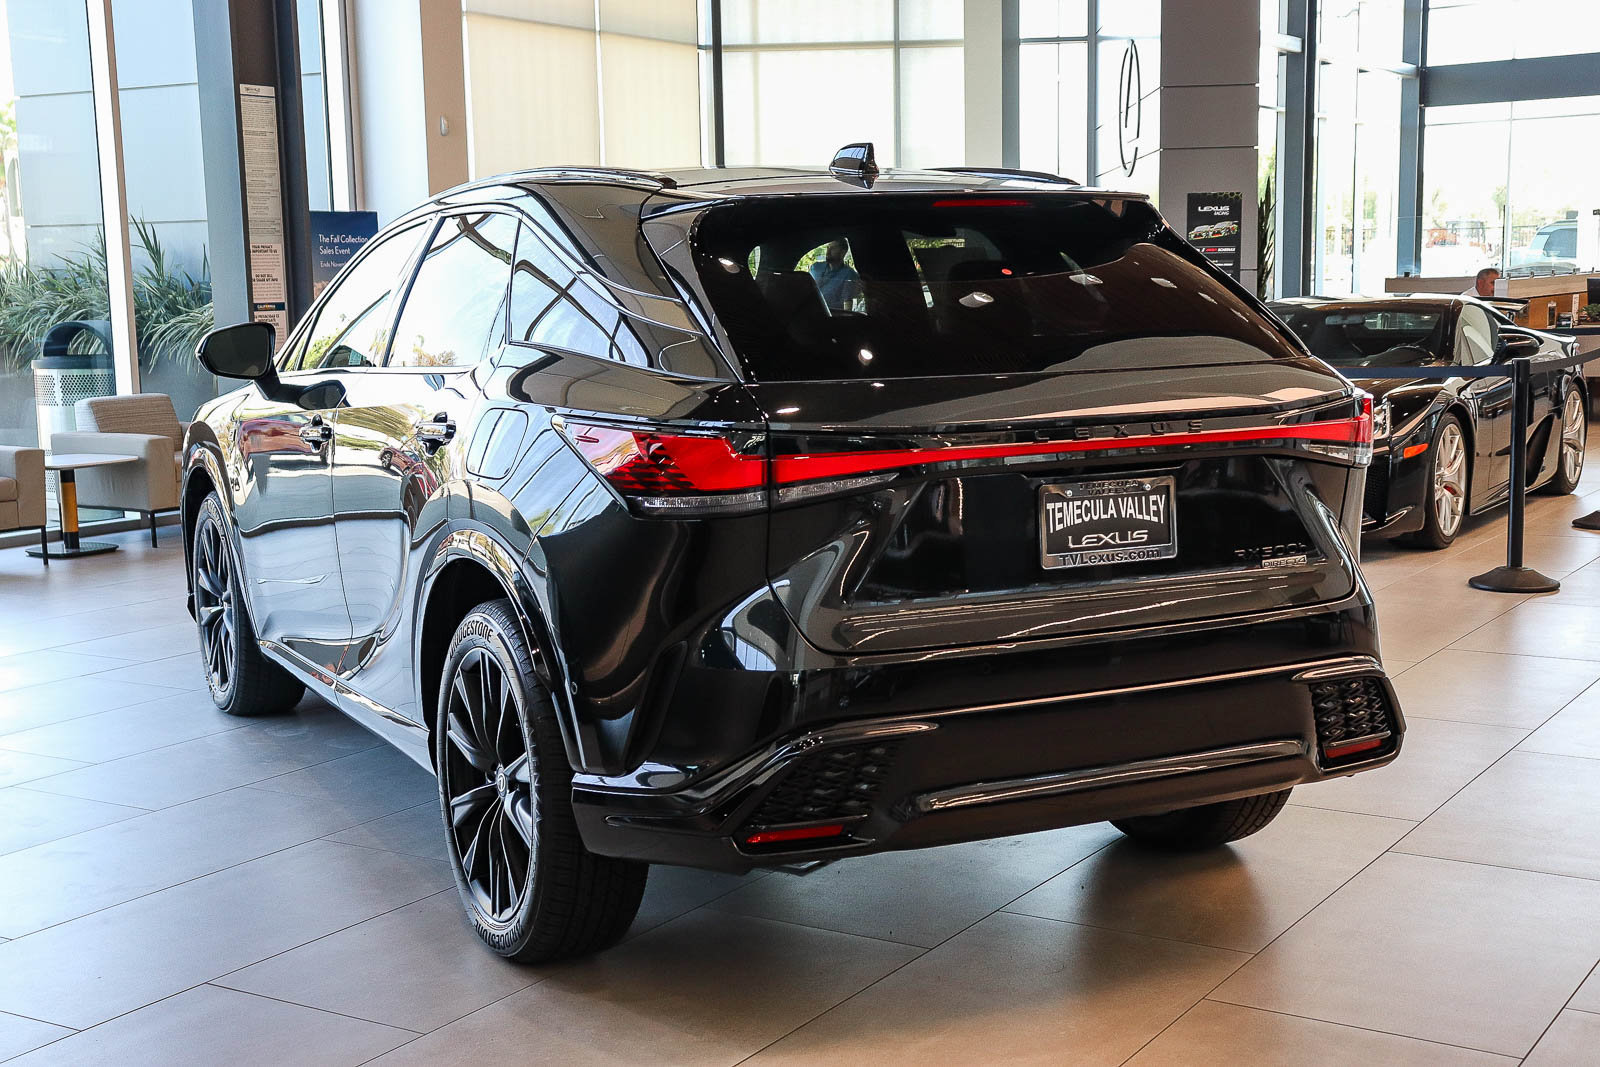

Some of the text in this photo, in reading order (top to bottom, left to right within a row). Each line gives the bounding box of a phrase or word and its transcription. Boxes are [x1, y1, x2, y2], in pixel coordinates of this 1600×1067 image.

[319, 234, 368, 243] The Fall Collection
[319, 245, 350, 255] Sales Event
[320, 260, 331, 268] Ends
[1032, 419, 1203, 443] LEXUS
[1046, 494, 1166, 534] TEMECULA VALLEY
[1067, 529, 1149, 549] LEXUS
[1058, 548, 1161, 567] TVLexus.com
